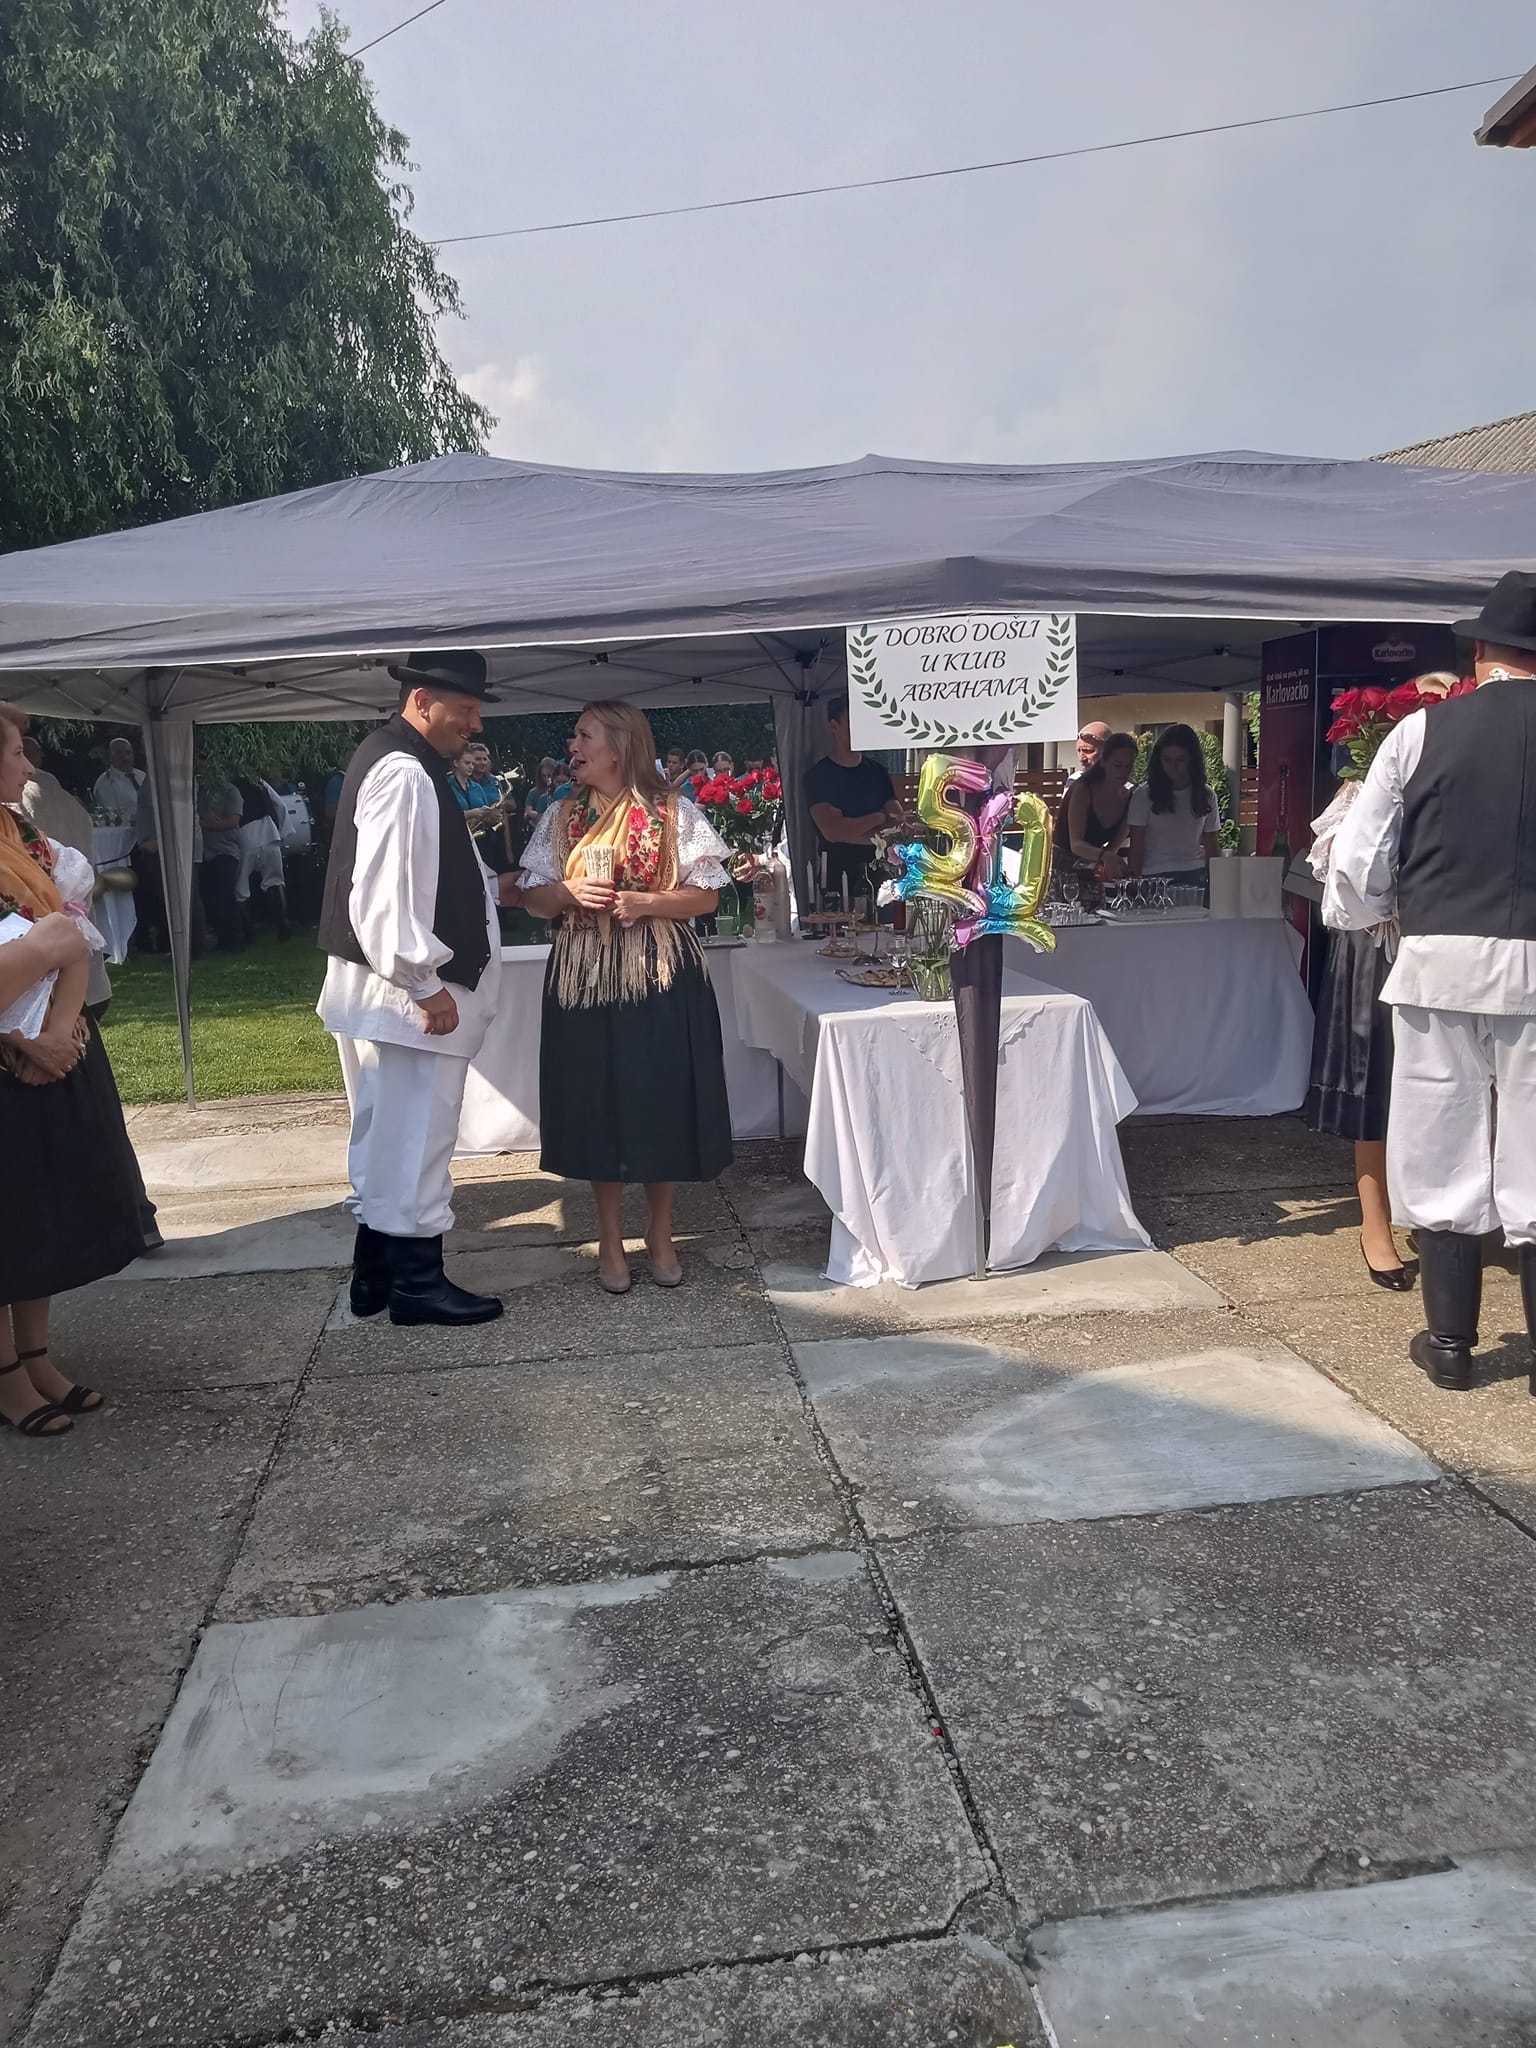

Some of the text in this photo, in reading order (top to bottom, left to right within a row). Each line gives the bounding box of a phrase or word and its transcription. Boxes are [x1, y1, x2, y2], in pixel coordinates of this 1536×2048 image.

[885, 616, 1040, 646] DOBRO DOŠLI
[920, 650, 1006, 673] U KLUB
[900, 677, 1029, 702] ABRAHAMA
[1266, 680, 1308, 704] Karlovačko
